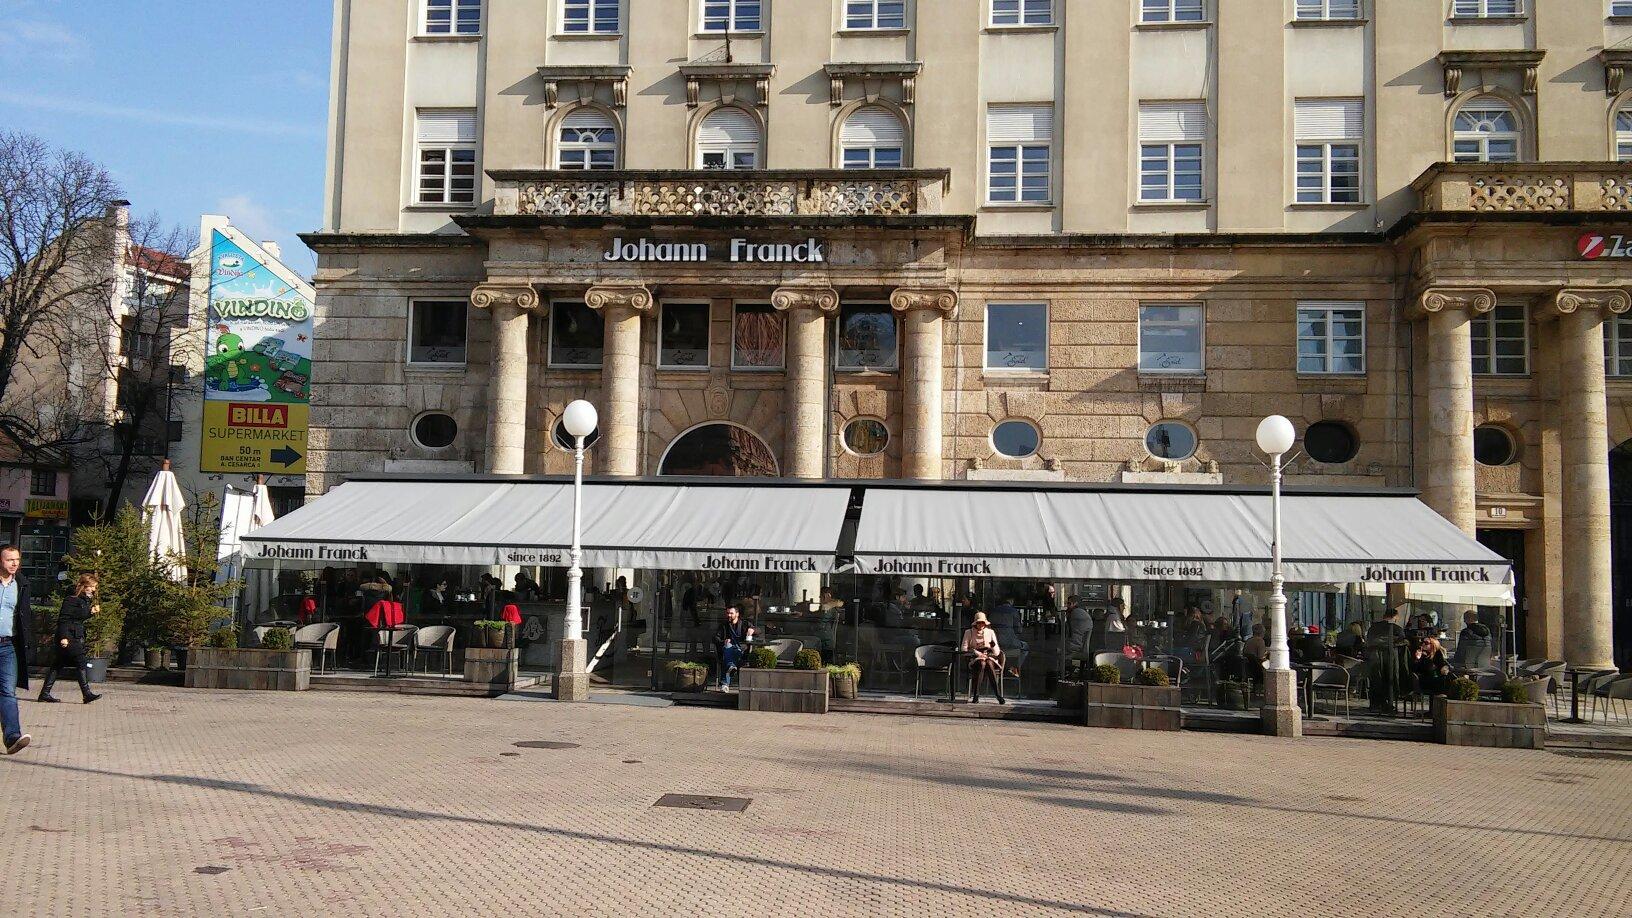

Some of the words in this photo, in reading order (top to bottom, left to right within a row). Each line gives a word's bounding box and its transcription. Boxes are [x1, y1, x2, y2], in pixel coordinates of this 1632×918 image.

[604, 238, 707, 262] Johann
[730, 238, 823, 262] Franck
[214, 299, 309, 320] VINDINO
[232, 407, 285, 425] BILLA
[209, 427, 305, 441] SUPERMARKET
[239, 446, 251, 455] 50
[1495, 506, 1503, 515] 10
[258, 544, 314, 559] Johann
[319, 546, 368, 560] Franck
[507, 551, 536, 563] since
[539, 554, 561, 563] 1892
[702, 556, 759, 570] Johann
[765, 557, 816, 571] Franck
[873, 559, 932, 573] Johann
[938, 560, 992, 574] Franck
[1143, 564, 1175, 576] since
[1178, 567, 1203, 576] 1892
[1360, 567, 1426, 581] Johann
[1431, 567, 1490, 582] Franck
